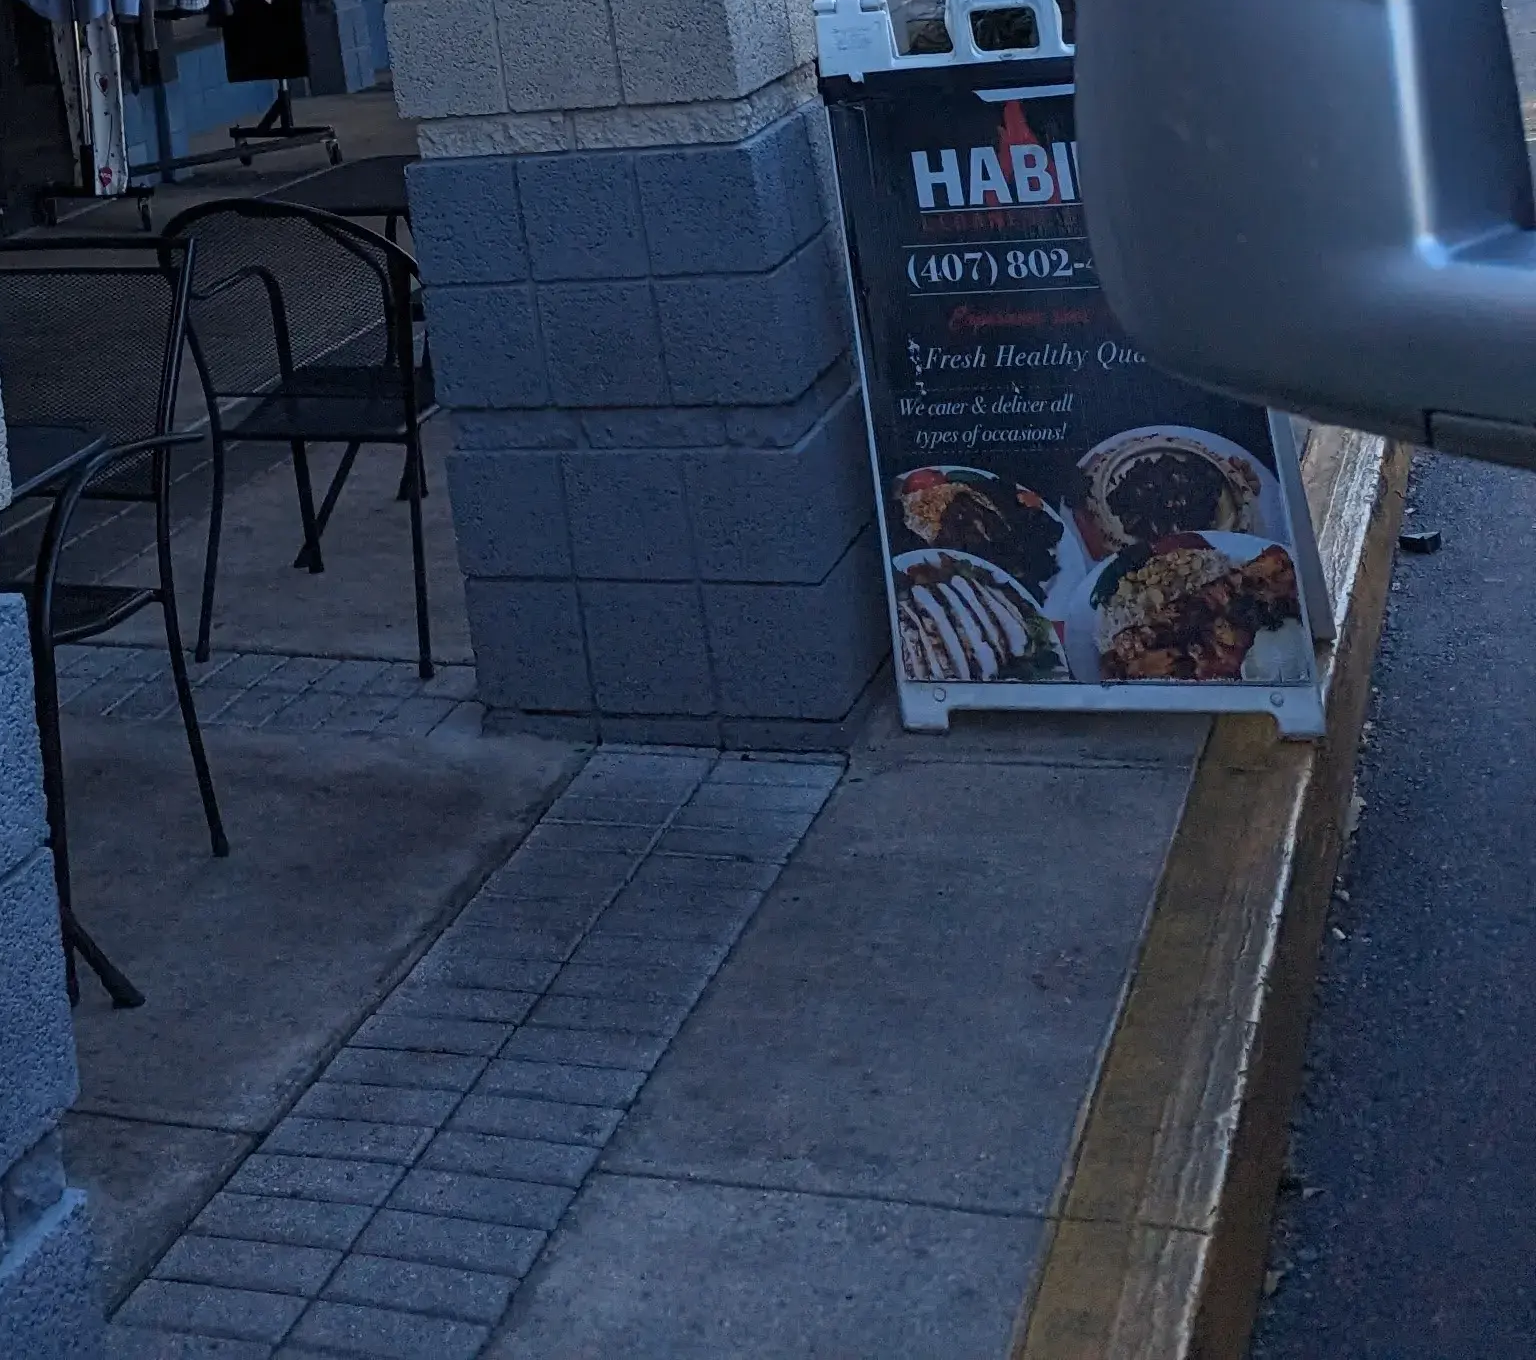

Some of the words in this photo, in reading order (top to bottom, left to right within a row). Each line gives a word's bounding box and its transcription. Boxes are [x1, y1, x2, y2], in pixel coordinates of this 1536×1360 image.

[907, 248, 999, 290] (407)
[923, 346, 988, 370] Fresh
[994, 342, 1090, 372] Healthy
[898, 397, 925, 417] We
[927, 400, 969, 417] cater
[970, 395, 988, 415] &
[991, 394, 1049, 415] deliver
[1050, 392, 1074, 413] all
[915, 427, 959, 449] types
[962, 423, 983, 449] of
[982, 422, 1067, 443] occasions!
